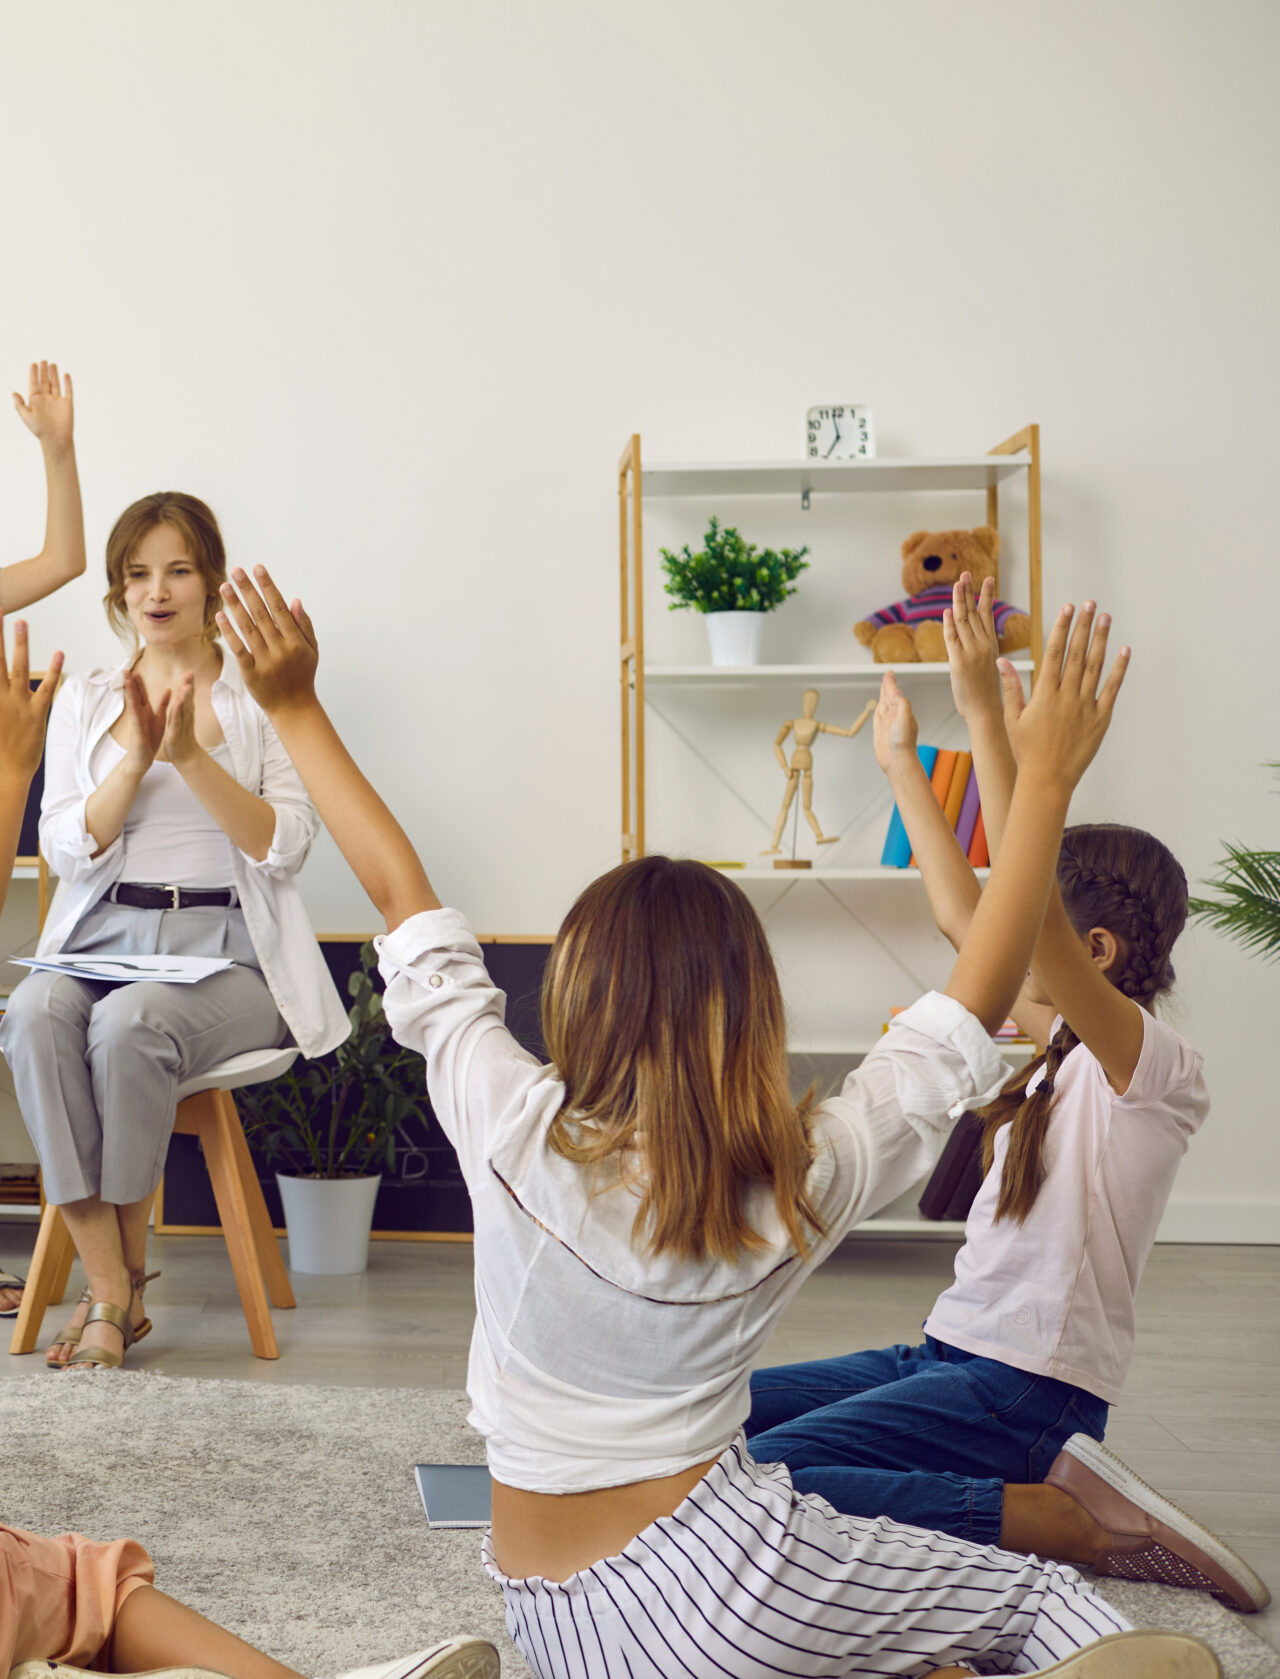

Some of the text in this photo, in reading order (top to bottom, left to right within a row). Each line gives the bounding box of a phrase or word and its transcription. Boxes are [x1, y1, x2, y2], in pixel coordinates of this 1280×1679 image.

[818, 410, 829, 419] 11
[831, 406, 844, 418] 12
[850, 408, 856, 418] 1
[808, 420, 821, 430] 10
[859, 418, 866, 428] 2
[808, 432, 816, 444] 9
[860, 431, 868, 442] 3
[810, 446, 818, 456] 8
[858, 444, 866, 455] 4
